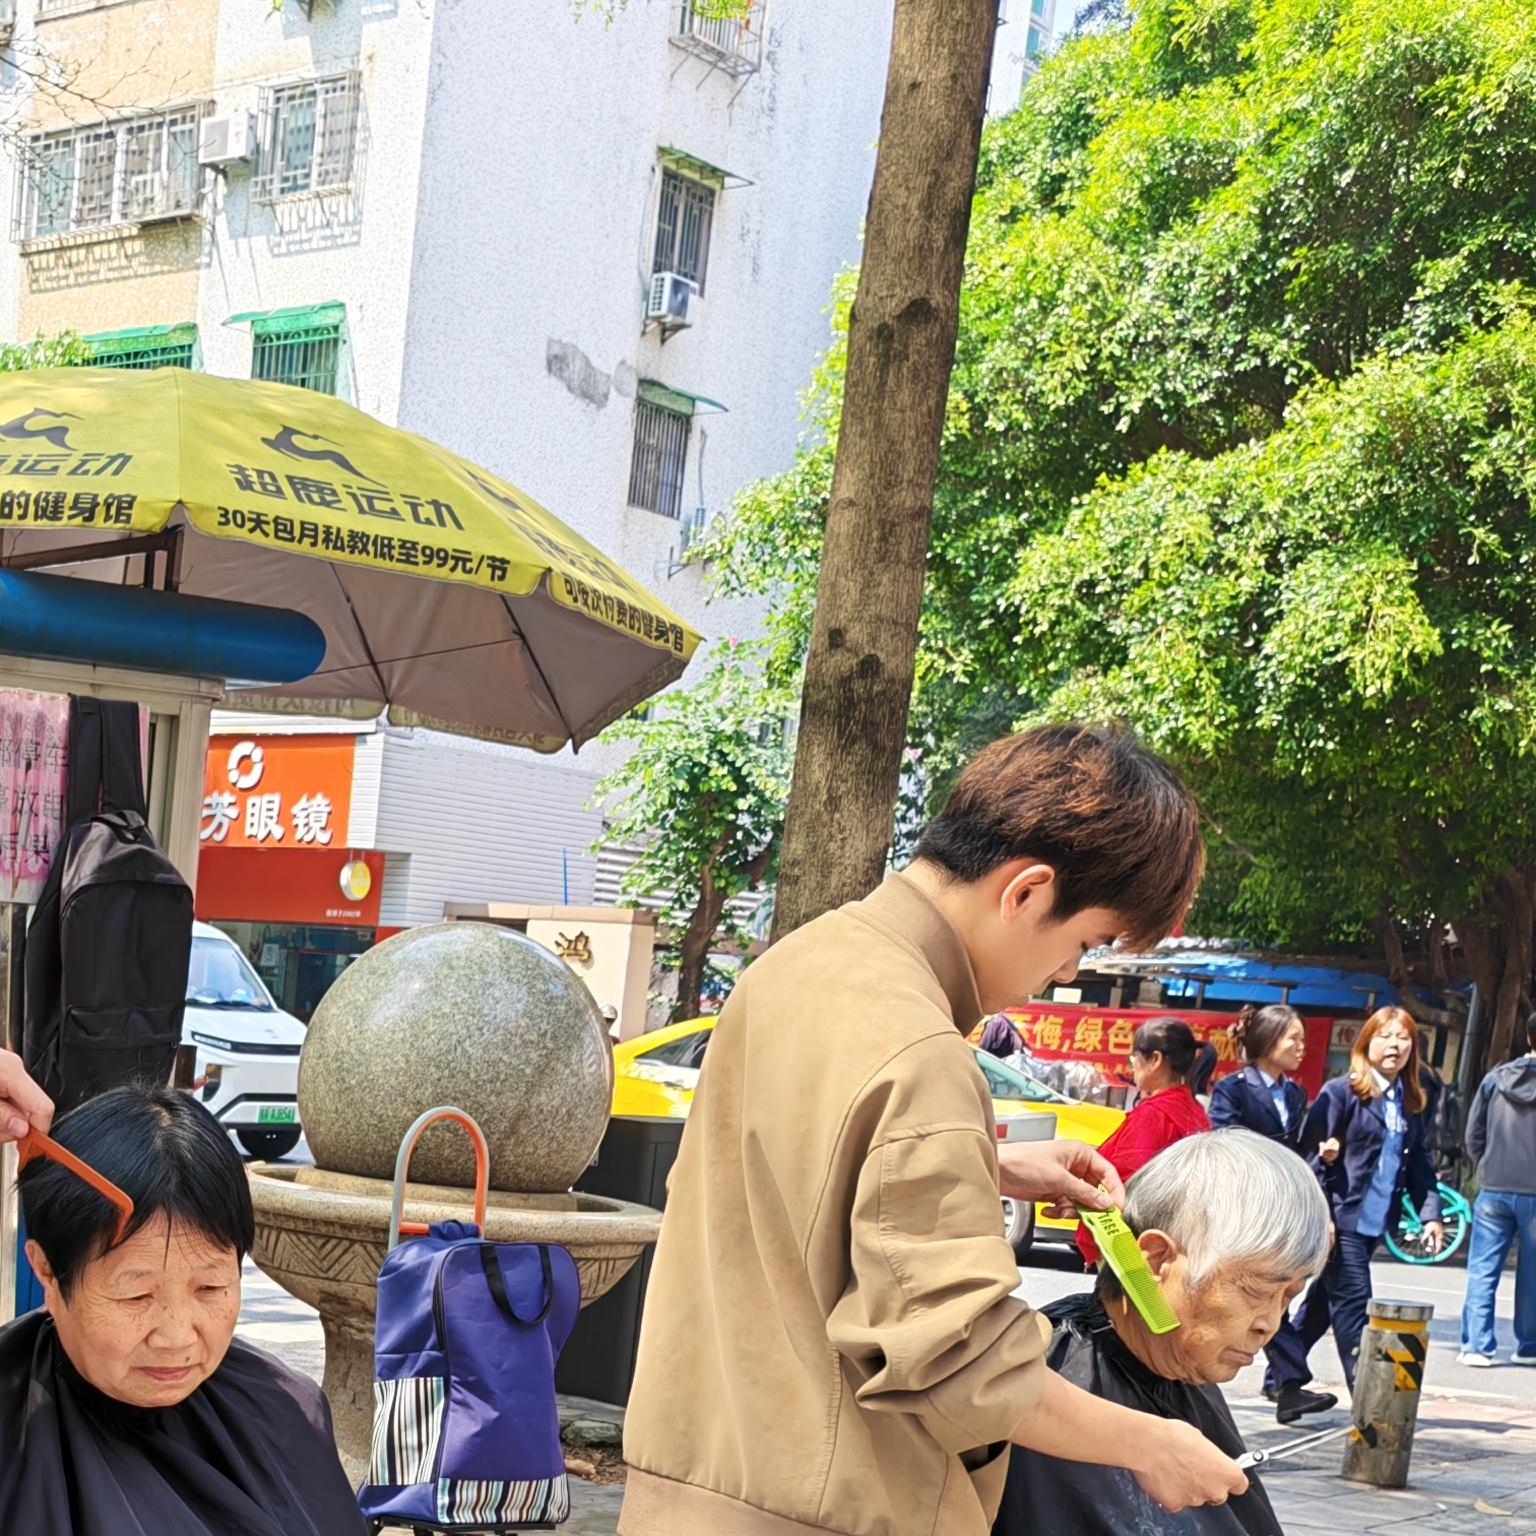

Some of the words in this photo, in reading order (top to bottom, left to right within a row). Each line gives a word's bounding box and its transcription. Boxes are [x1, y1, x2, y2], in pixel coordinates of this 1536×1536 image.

[225, 462, 465, 531] 超鹿运动
[216, 506, 512, 582] 30天包月私教低至99元/节
